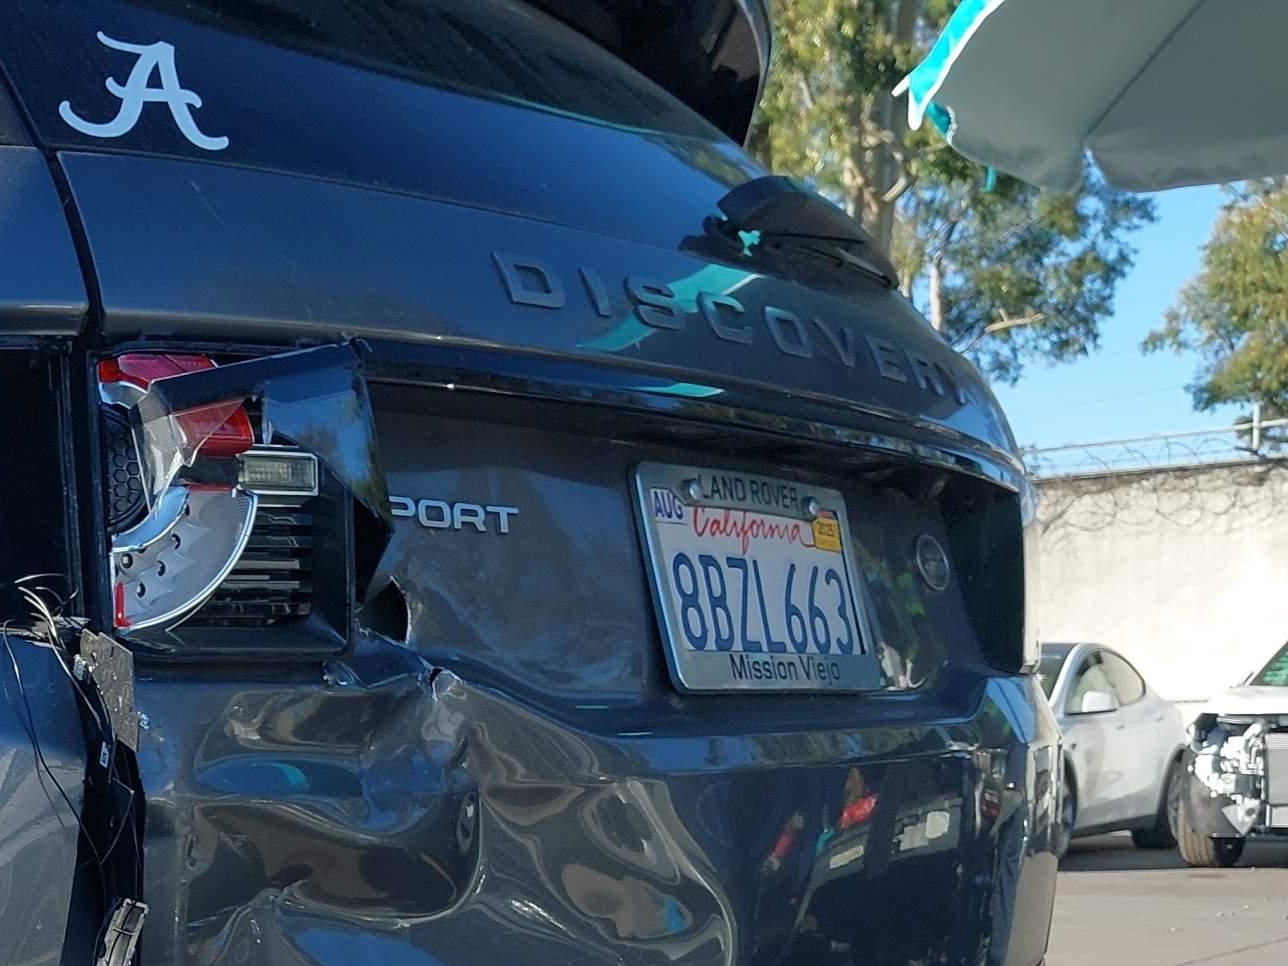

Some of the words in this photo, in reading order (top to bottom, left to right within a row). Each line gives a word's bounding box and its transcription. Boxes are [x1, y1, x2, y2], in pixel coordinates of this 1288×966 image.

[58, 30, 229, 150] A
[388, 495, 520, 534] PORT
[654, 490, 683, 520] AUG
[751, 480, 799, 511] ROVER
[693, 506, 816, 555] California
[672, 551, 853, 655] 8BZL663
[729, 653, 799, 680] Mission
[799, 655, 840, 686] Viejo
